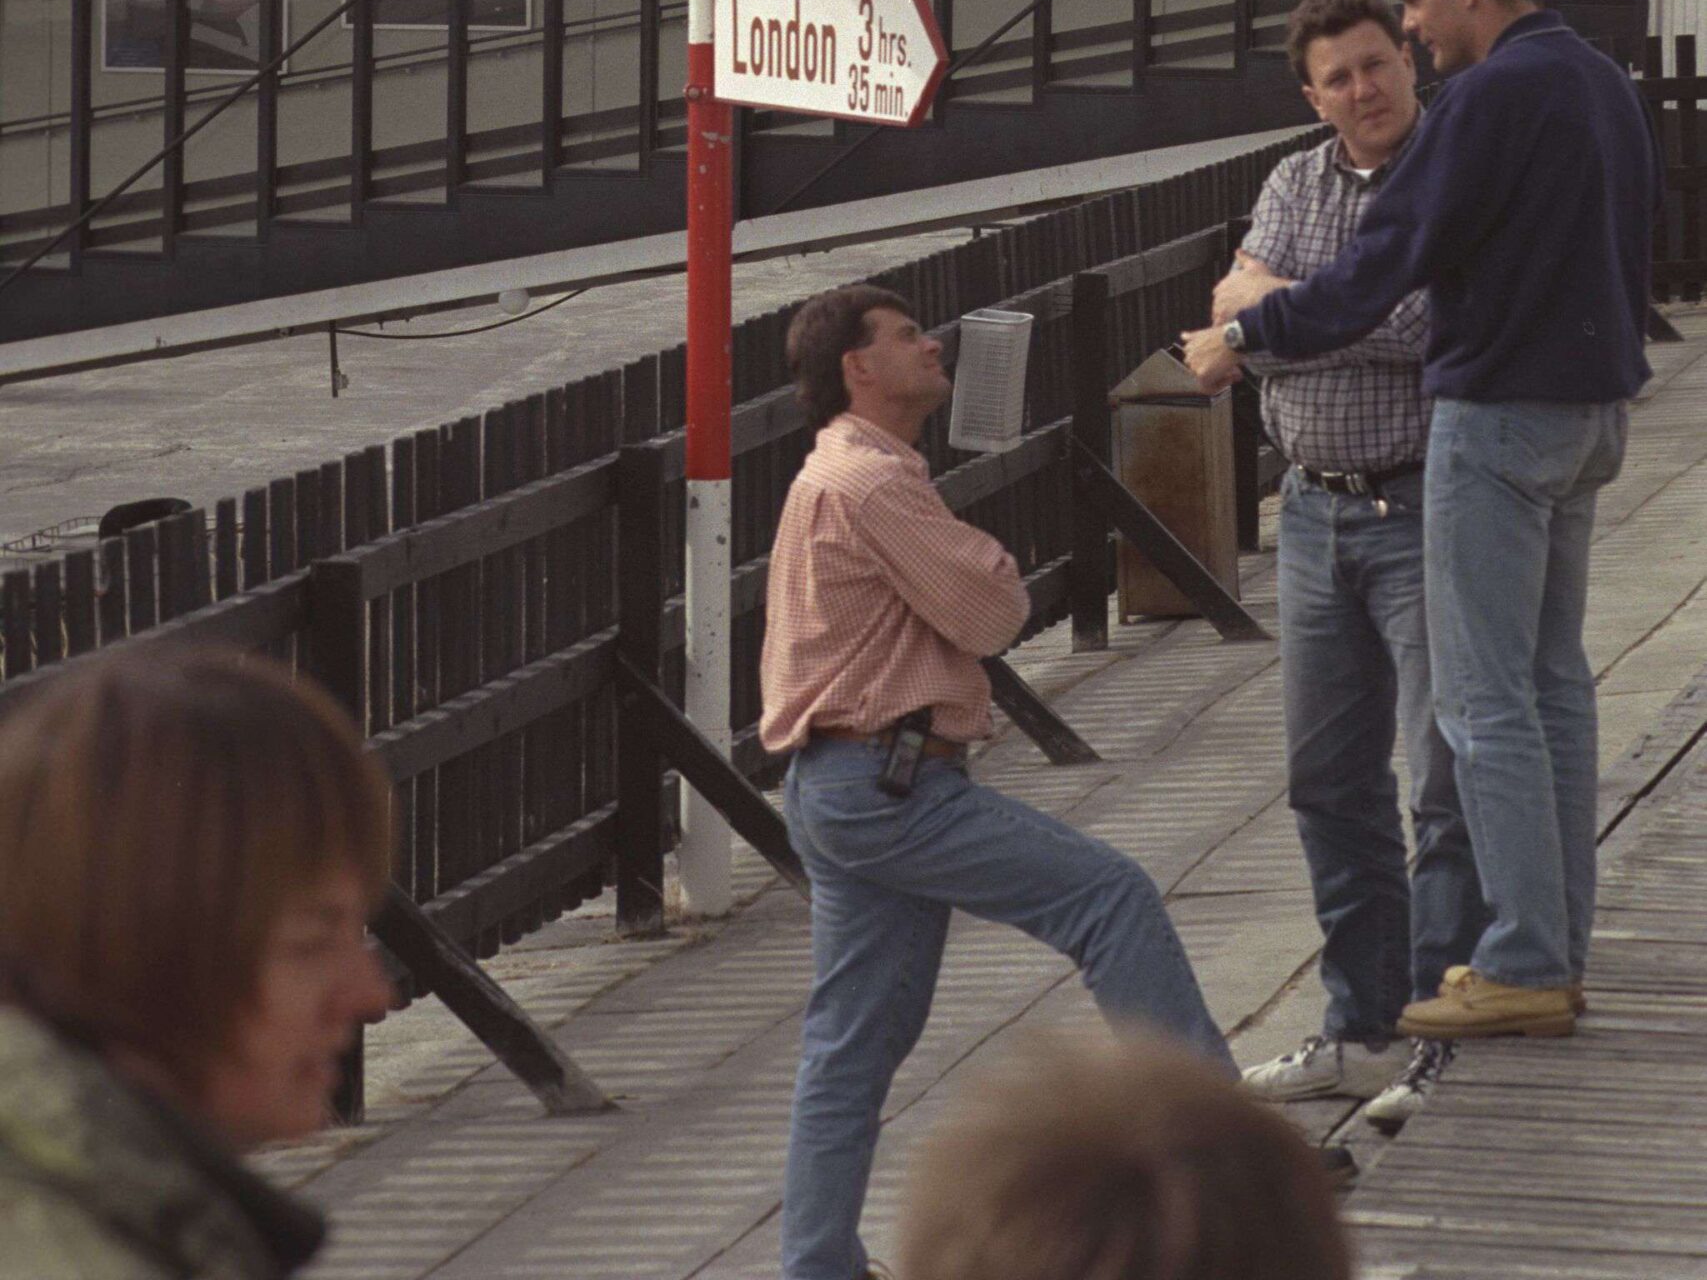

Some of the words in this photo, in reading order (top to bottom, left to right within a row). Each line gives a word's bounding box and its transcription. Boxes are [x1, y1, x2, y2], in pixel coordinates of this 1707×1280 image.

[879, 16, 912, 68] hrs.
[848, 63, 870, 112] 35
[874, 71, 908, 117] min.
